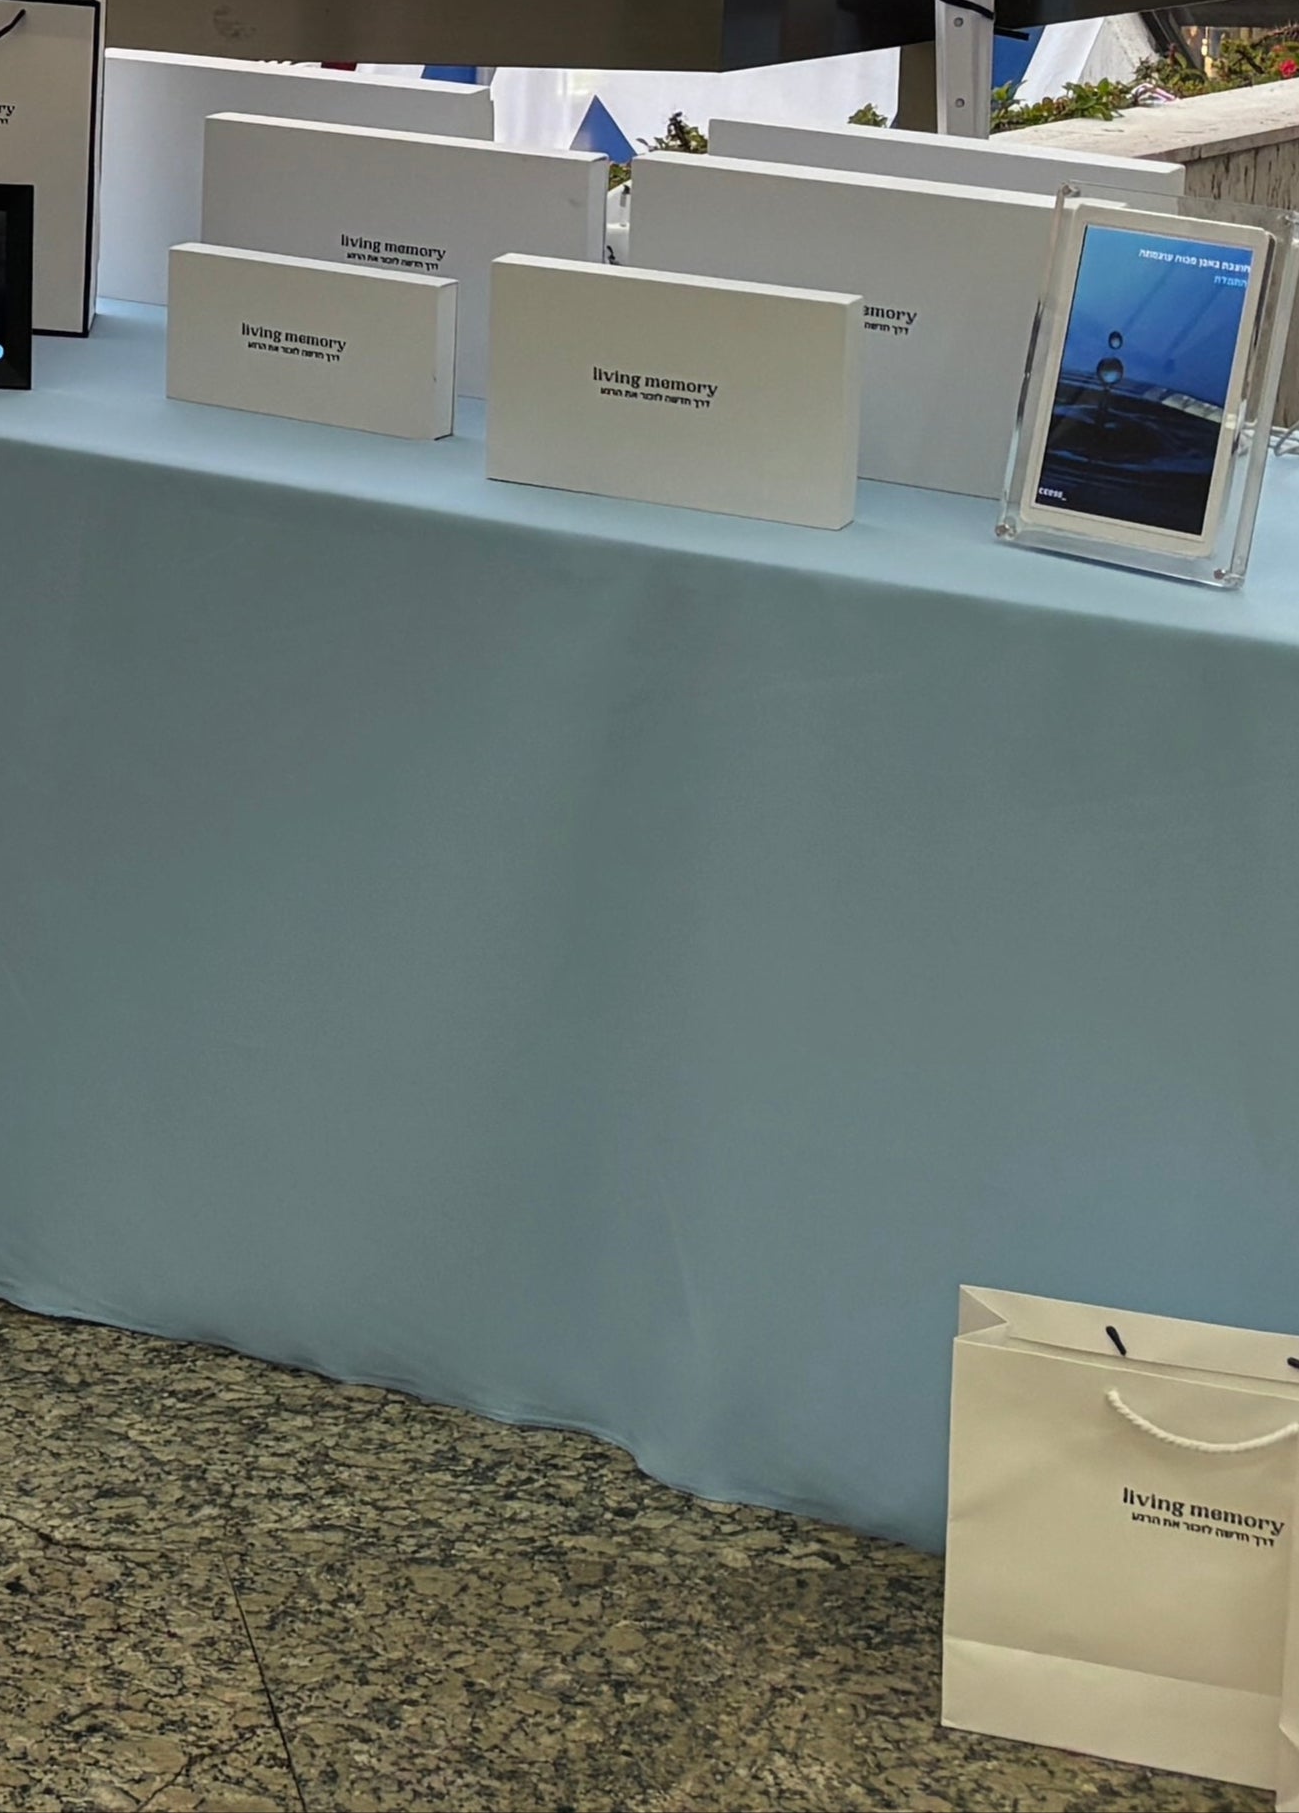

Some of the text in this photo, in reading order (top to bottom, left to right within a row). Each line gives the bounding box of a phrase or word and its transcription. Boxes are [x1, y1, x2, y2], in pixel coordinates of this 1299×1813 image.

[341, 234, 446, 261] living memory
[242, 322, 346, 353] living memory
[593, 366, 718, 398] living memory
[1123, 1487, 1285, 1536] living memory
